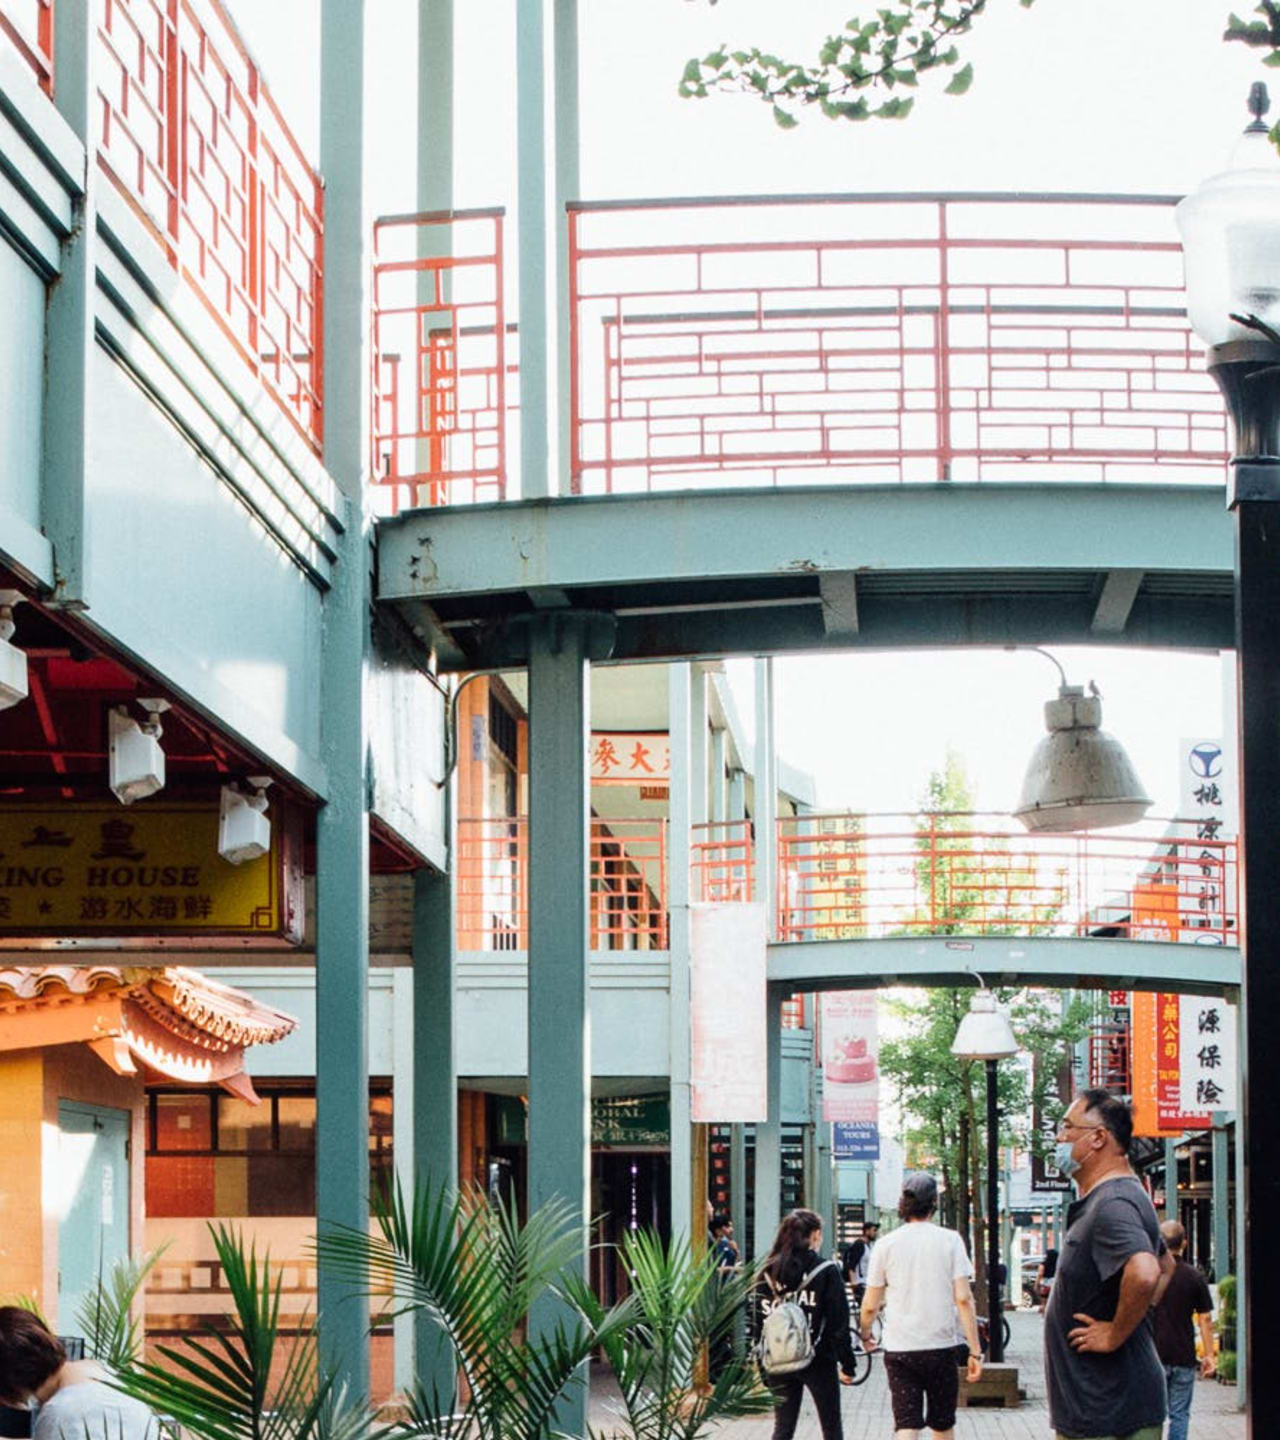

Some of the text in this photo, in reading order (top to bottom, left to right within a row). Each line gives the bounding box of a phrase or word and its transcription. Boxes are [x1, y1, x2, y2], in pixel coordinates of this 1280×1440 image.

[592, 738, 670, 777] 參大
[85, 866, 202, 889] HOUSE
[1195, 1008, 1225, 1107] 源保險
[842, 1131, 871, 1139] TOURS
[1051, 1180, 1070, 1189] Floor
